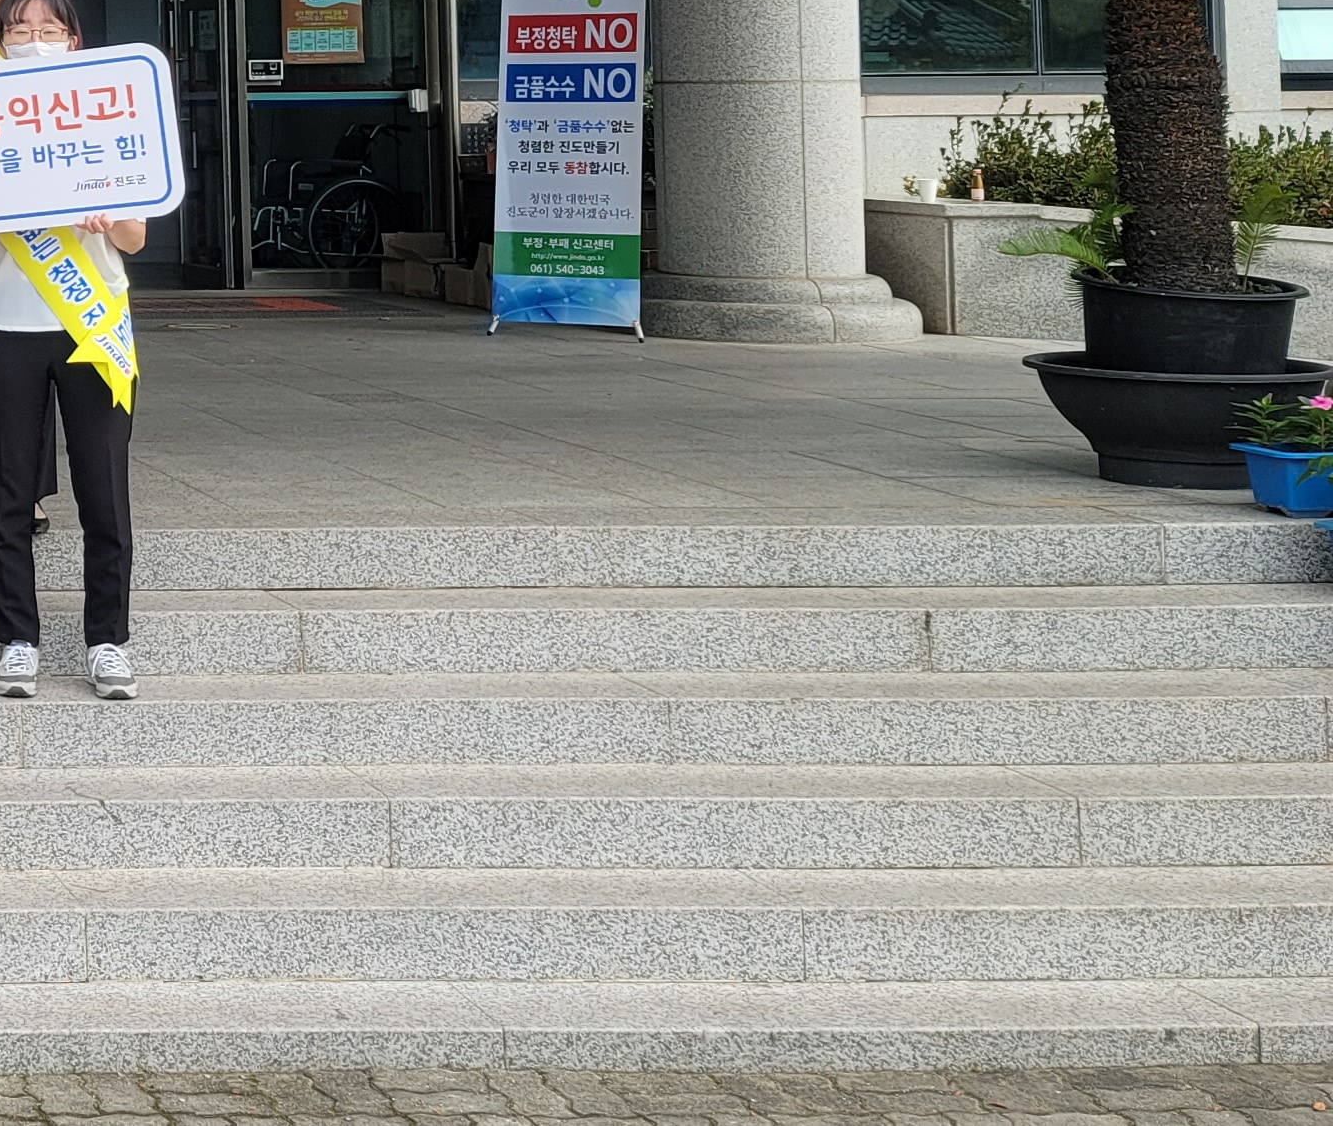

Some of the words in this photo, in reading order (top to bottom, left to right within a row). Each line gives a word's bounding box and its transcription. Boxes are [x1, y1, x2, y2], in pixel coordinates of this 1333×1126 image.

[516, 26, 577, 50] 부정청탁
[585, 18, 633, 49] NO
[514, 76, 576, 98] 금품수수
[583, 67, 631, 99] NO
[32, 140, 104, 169] 바꾸는
[115, 134, 146, 161] 힘!
[518, 140, 554, 153] 청렴한
[559, 140, 620, 154] 진도만들기
[508, 161, 531, 174] 우리
[535, 161, 560, 174] 모두
[564, 161, 629, 175] 동참합시다.
[73, 176, 109, 191] Jindo
[114, 174, 147, 187] 진도군
[566, 193, 610, 205] 대한민국
[506, 206, 549, 218] 진도군이
[572, 239, 614, 251] 신고센터
[530, 264, 552, 274] 061)
[555, 265, 604, 275] 540-3043
[48, 257, 91, 303] 청정
